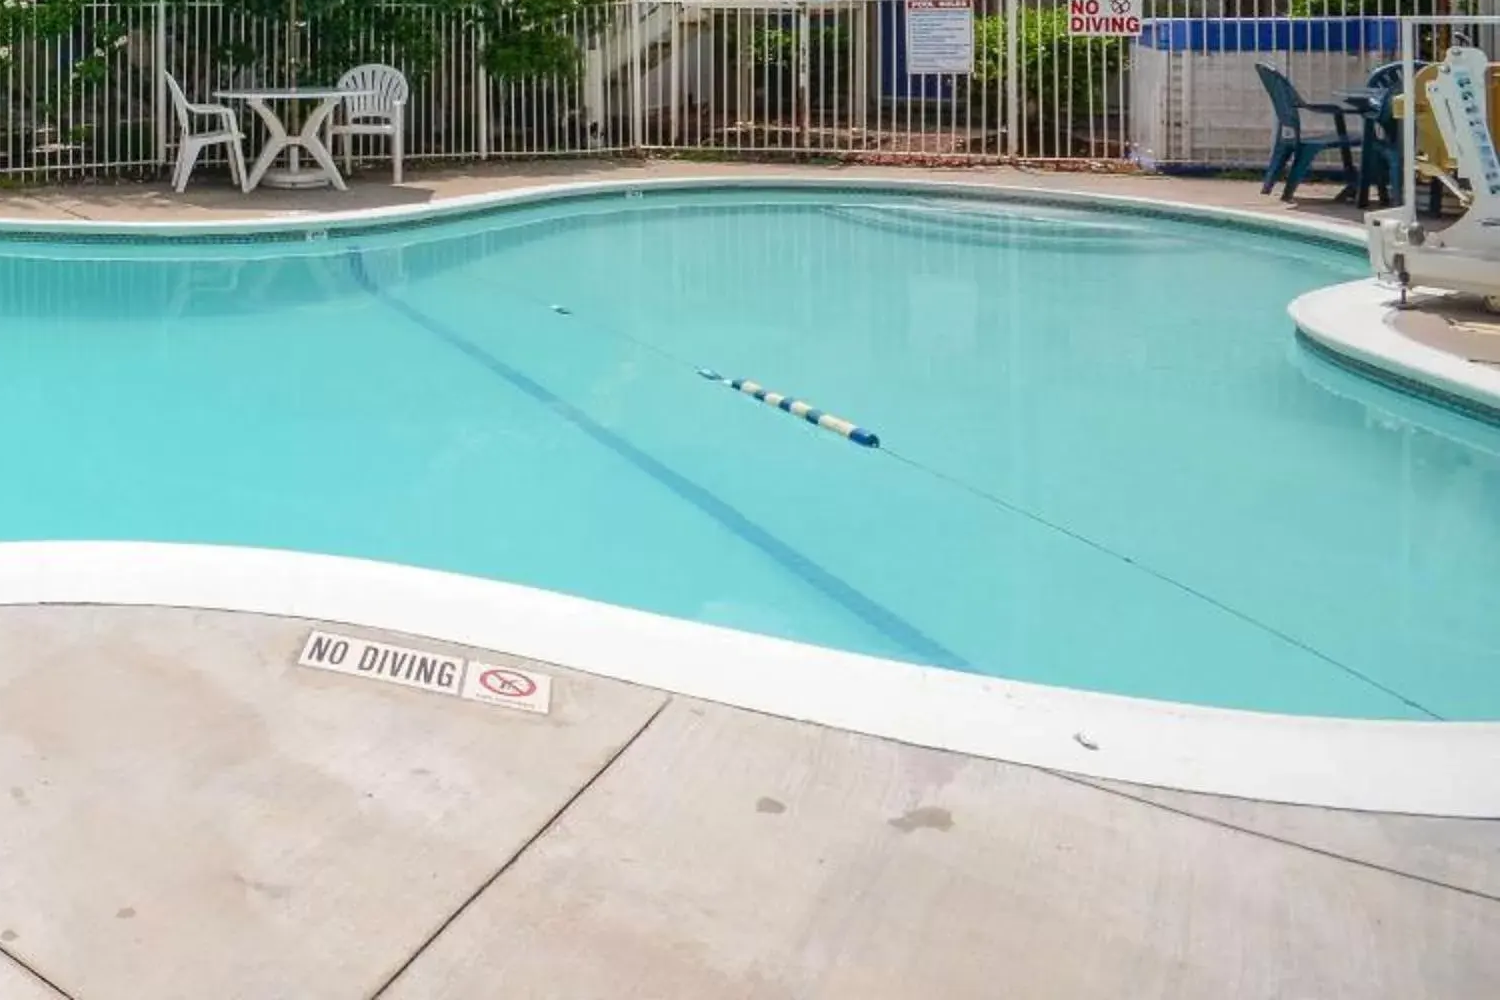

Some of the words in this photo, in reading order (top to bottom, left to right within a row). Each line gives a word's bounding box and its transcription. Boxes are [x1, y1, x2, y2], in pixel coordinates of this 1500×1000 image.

[1071, 0, 1099, 15] NO
[1071, 16, 1140, 33] DIVING
[307, 635, 349, 665] NO
[358, 645, 457, 689] DIVING
